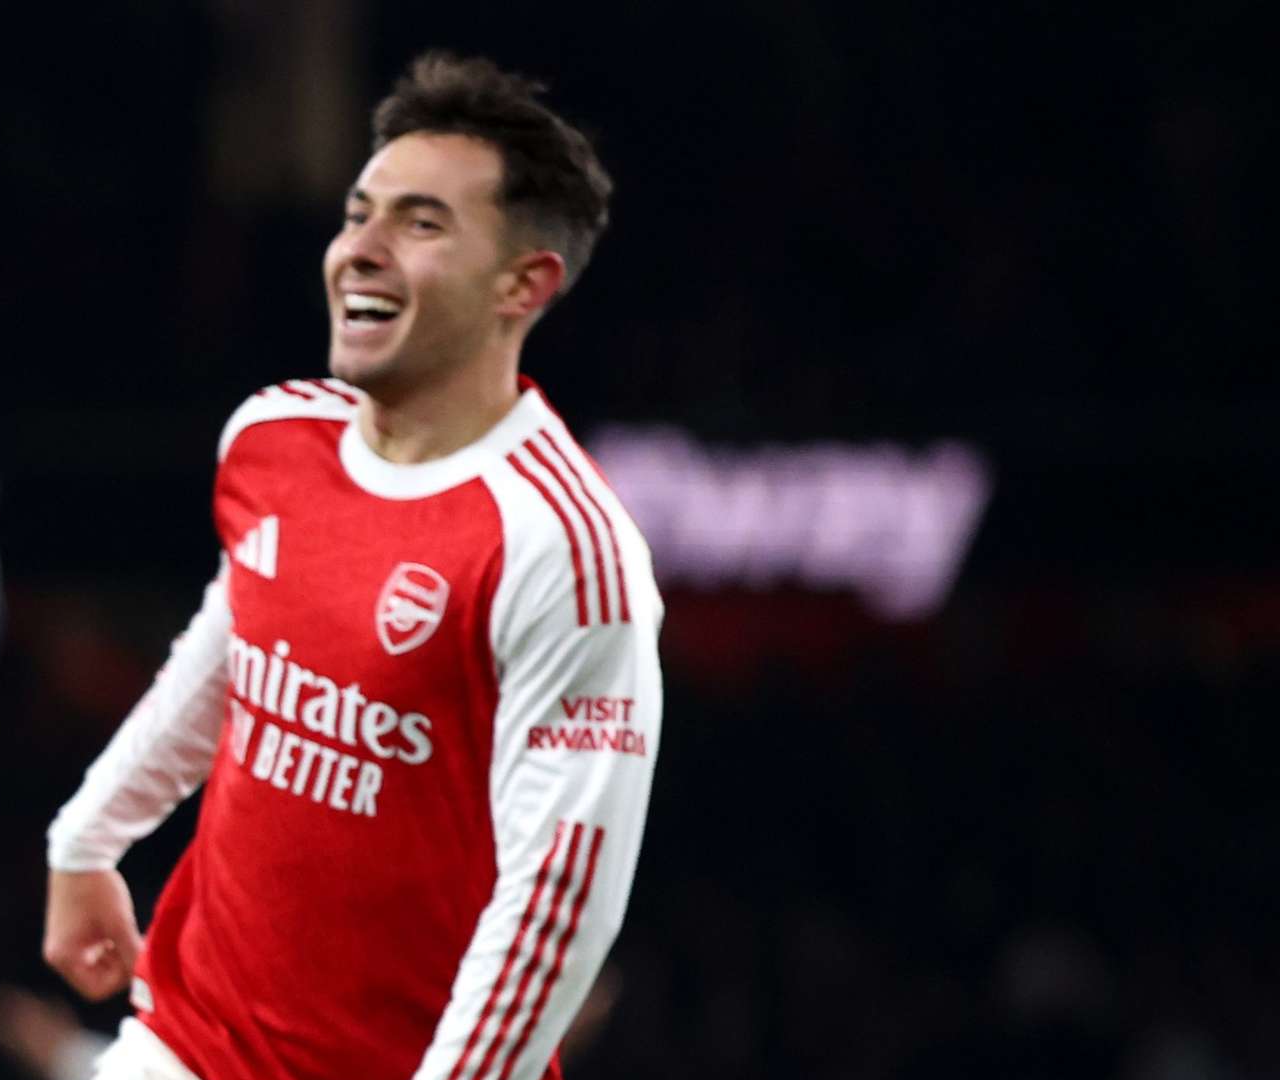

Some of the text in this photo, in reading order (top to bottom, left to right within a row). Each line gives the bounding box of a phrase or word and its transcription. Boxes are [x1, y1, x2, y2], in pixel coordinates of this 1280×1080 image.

[229, 637, 432, 765] mirates
[560, 696, 634, 722] VISIT
[252, 721, 383, 817] BETTER
